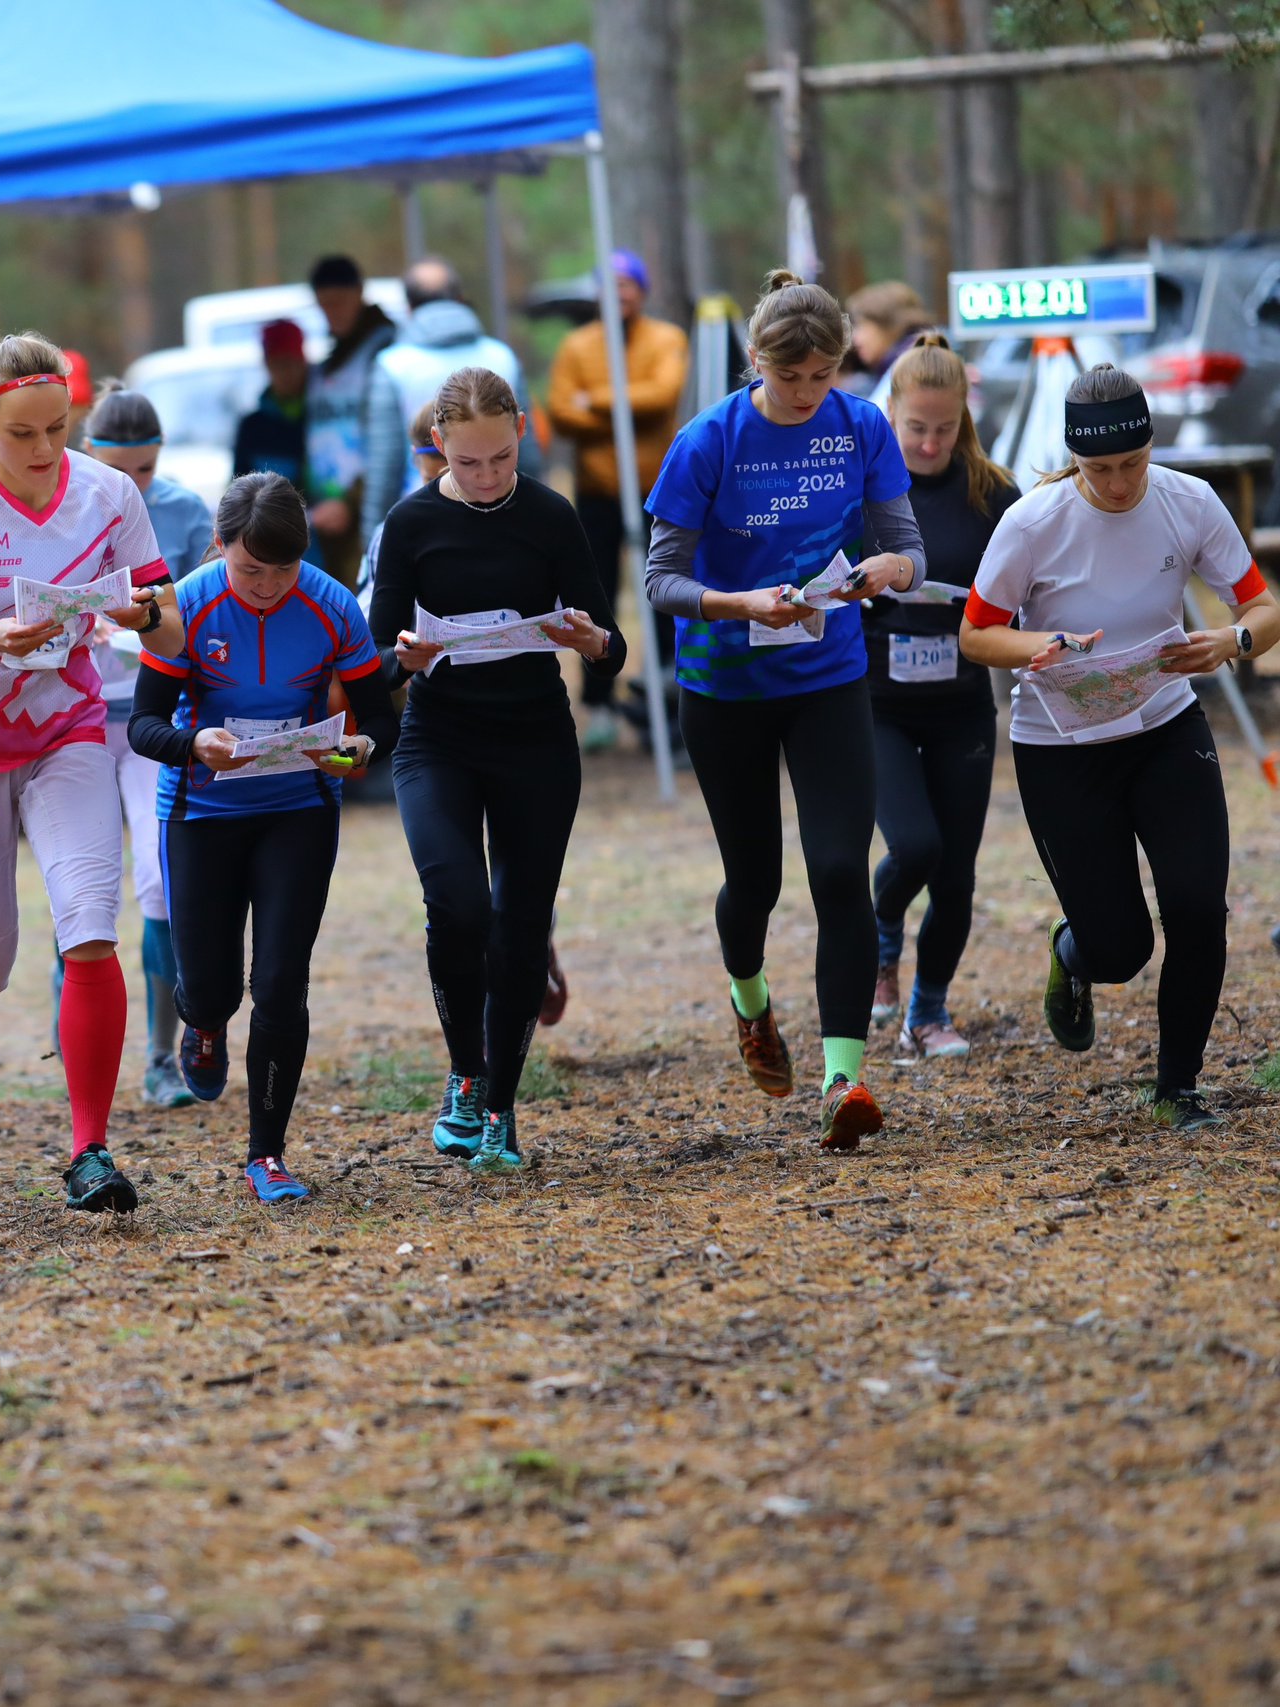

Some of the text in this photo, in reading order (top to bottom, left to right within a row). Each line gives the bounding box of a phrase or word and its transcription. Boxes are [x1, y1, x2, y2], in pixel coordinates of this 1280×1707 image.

[1075, 416, 1148, 436] ORIENTEAM
[809, 435, 855, 455] 2025
[735, 456, 846, 473] ТРОПА ЗАЙЦЕВА
[736, 477, 791, 490] ТЮМЕНЬ
[797, 472, 846, 493] 2024
[770, 495, 809, 511] 2023
[746, 513, 780, 526] 2022
[912, 650, 940, 666] 120
